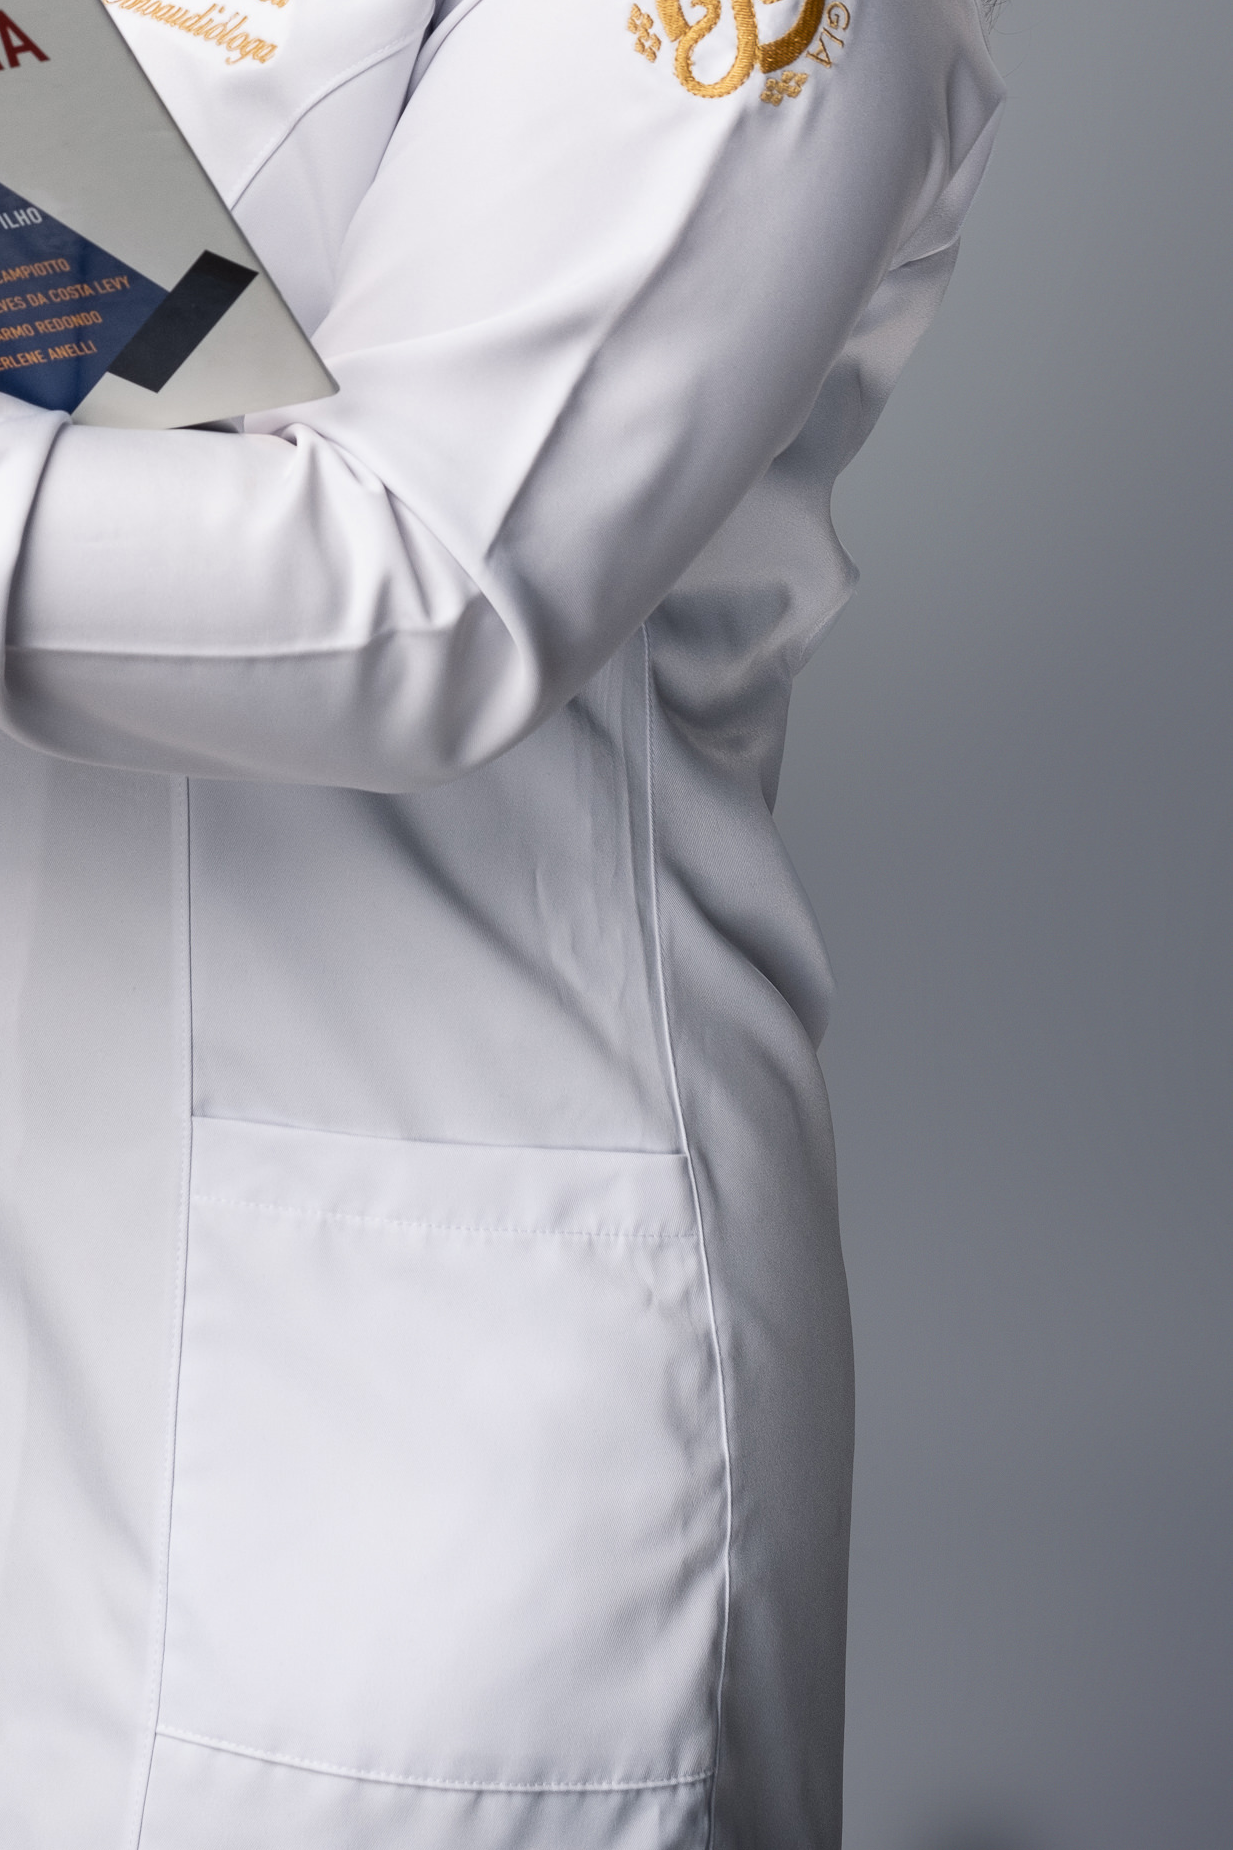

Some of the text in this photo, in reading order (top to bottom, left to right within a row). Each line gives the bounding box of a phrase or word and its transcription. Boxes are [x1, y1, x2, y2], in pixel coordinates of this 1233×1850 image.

[27, 292, 49, 308] DA
[48, 283, 96, 303] COSTA
[93, 275, 131, 294] LEVY
[34, 310, 103, 334] REDONDO
[48, 340, 98, 361] ANELLI
